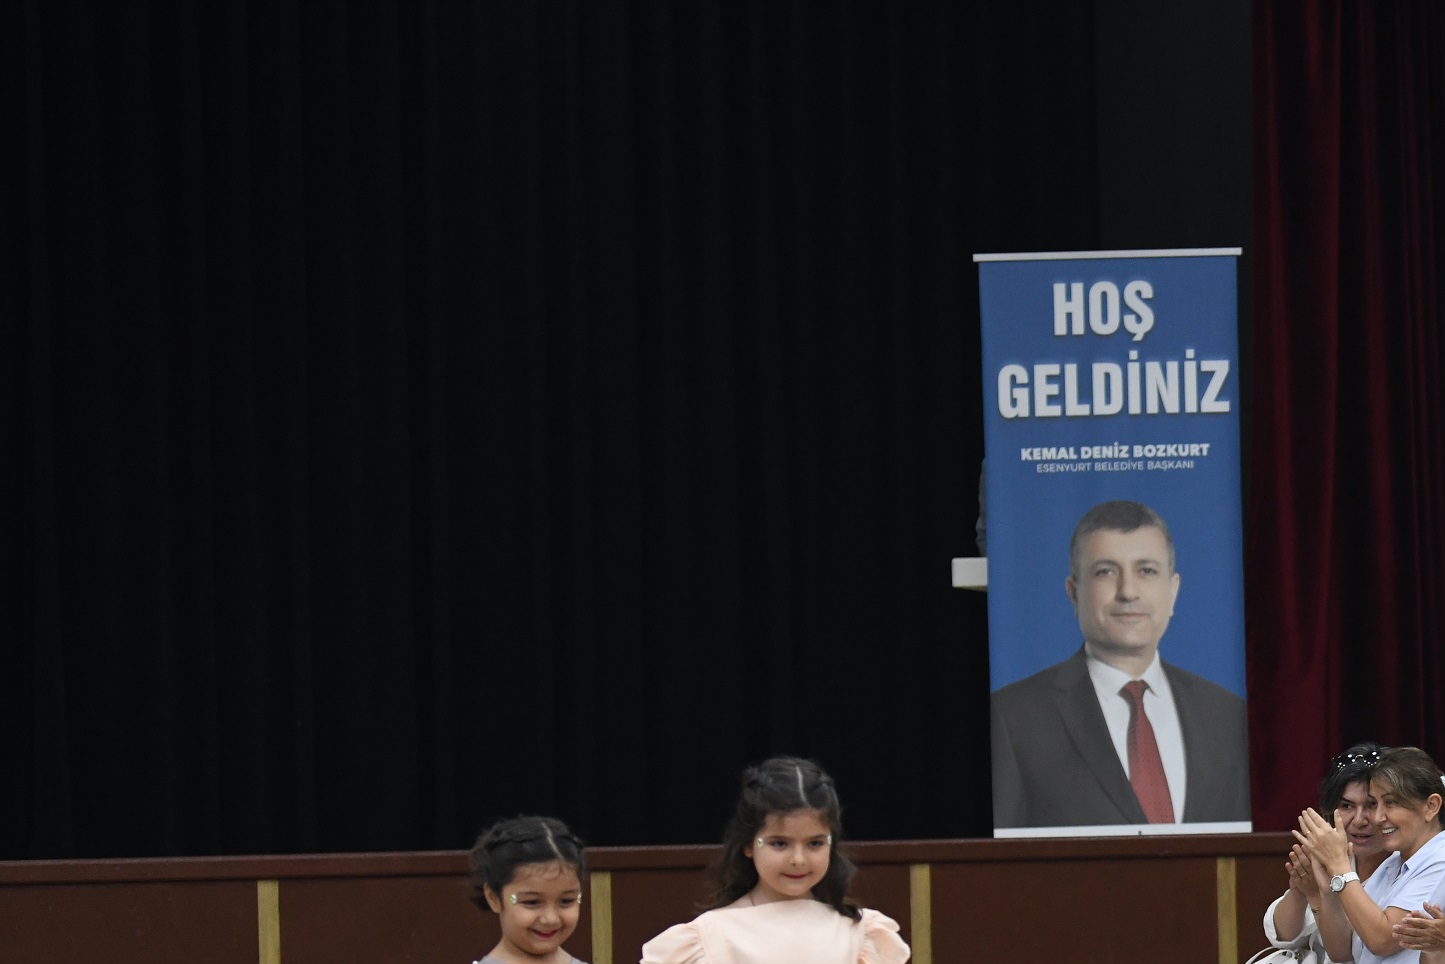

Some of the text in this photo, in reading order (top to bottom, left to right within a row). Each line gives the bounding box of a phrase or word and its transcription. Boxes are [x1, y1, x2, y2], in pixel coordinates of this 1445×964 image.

[1053, 280, 1155, 342] HOŞ
[998, 349, 1231, 419] GELDİNİZ
[1020, 442, 1211, 461] KEMAL DENİZ BOZKURT
[1036, 459, 1194, 473] ESENYURT BELEDİYE BAŞKANI
